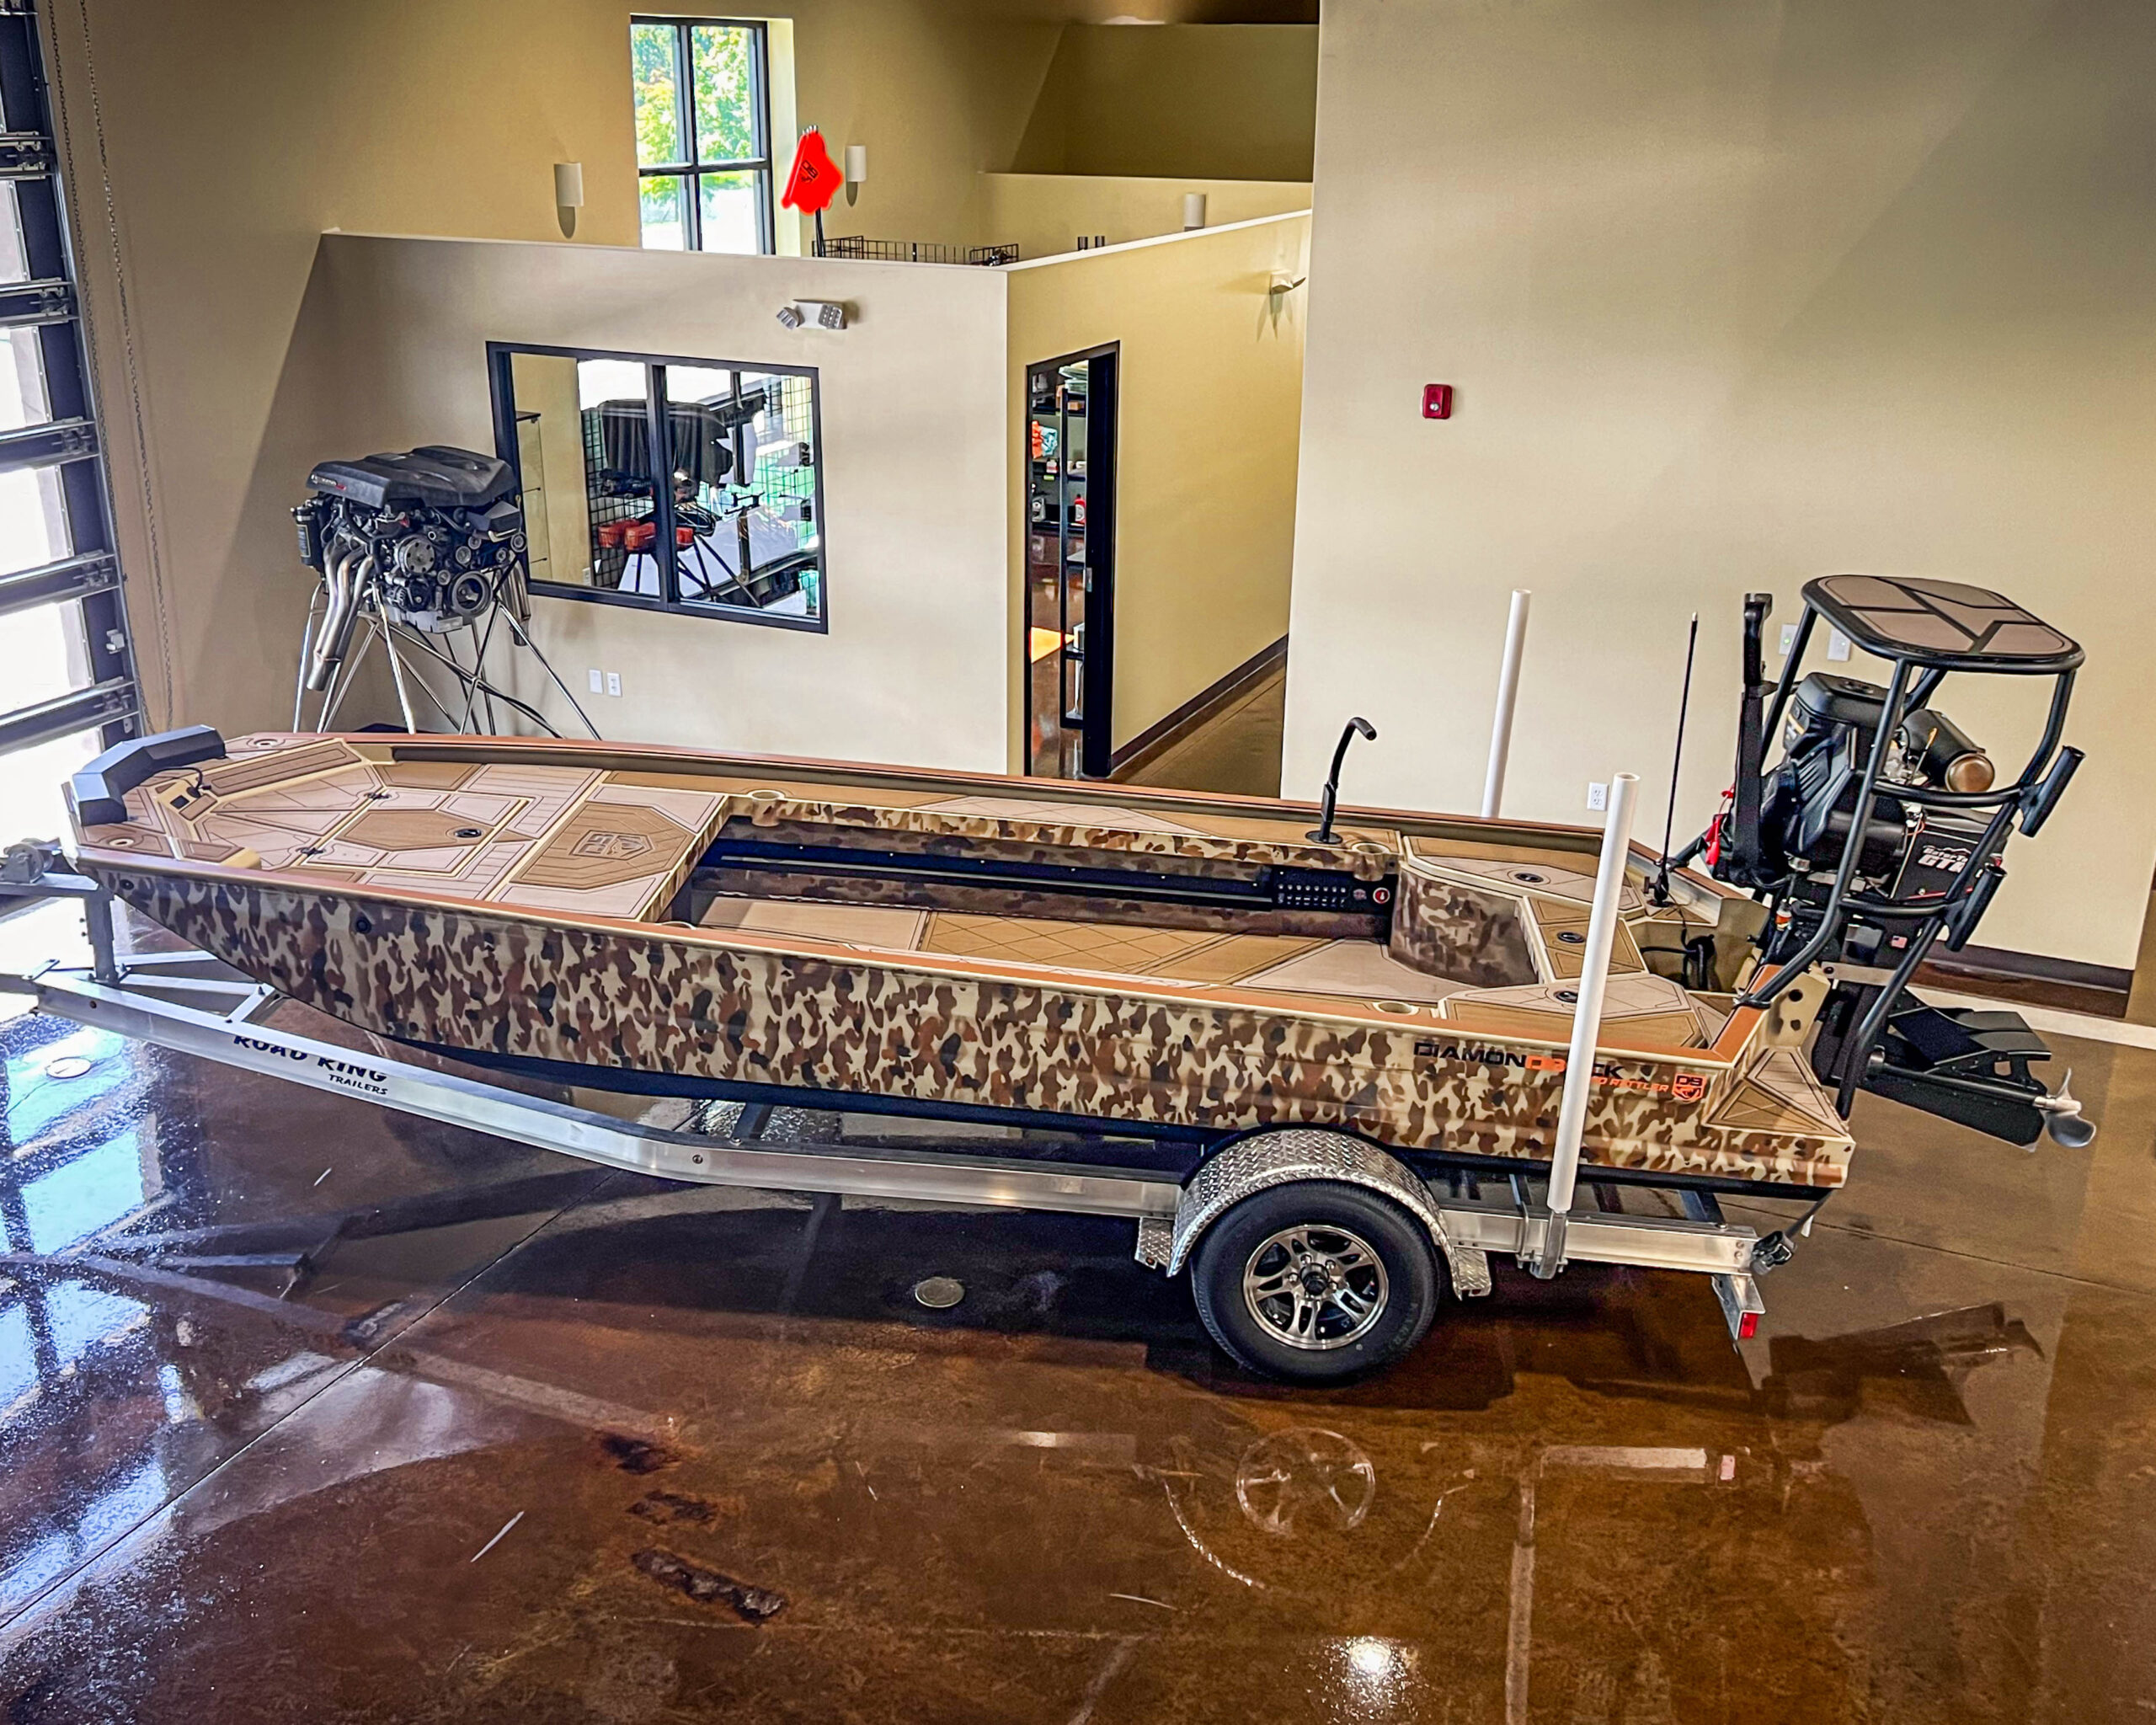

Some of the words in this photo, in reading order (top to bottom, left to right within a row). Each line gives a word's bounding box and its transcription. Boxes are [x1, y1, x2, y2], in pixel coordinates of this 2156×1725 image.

[232, 1035, 308, 1061] ROAD
[317, 1056, 388, 1083] KING
[1413, 1041, 1625, 1079] DIAMONDBCK
[328, 1073, 388, 1095] TRAILERS
[1609, 1078, 1670, 1092] RATTLER
[1675, 1074, 1704, 1087] DB
